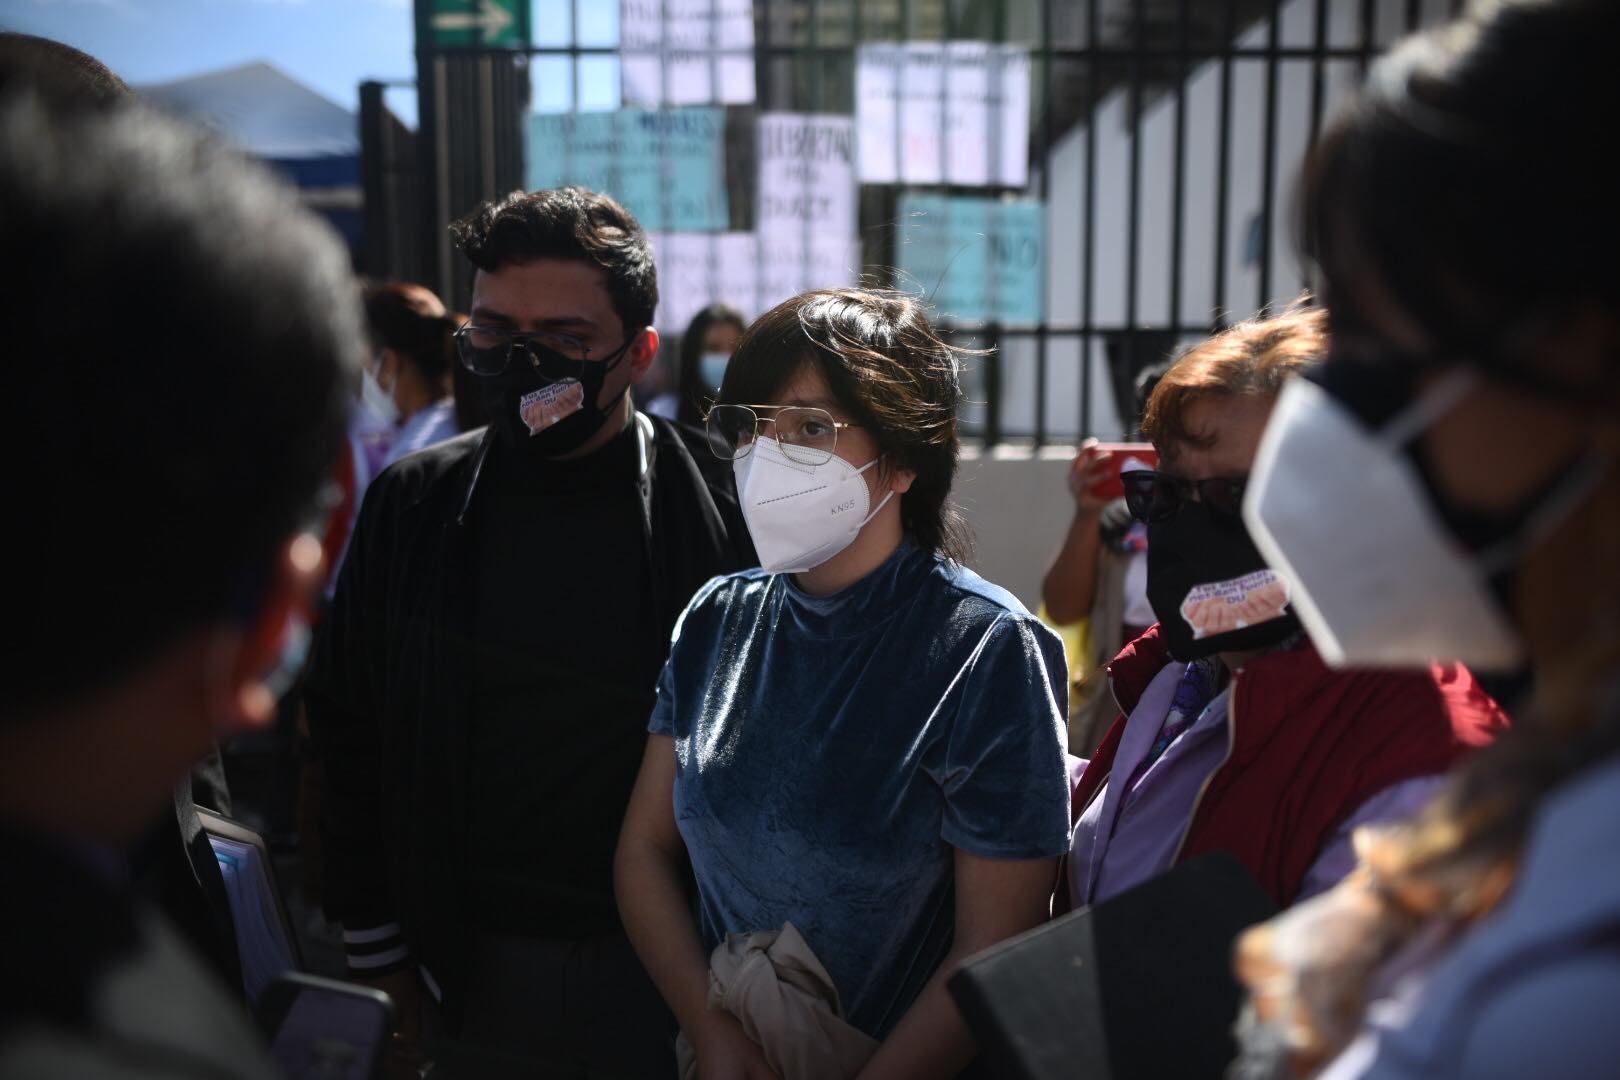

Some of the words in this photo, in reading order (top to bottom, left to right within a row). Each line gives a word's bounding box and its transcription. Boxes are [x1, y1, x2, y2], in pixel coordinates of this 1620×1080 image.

[535, 391, 551, 402] dan
[544, 396, 556, 406] DU
[831, 499, 855, 515] KN95
[1226, 595, 1246, 605] DU
